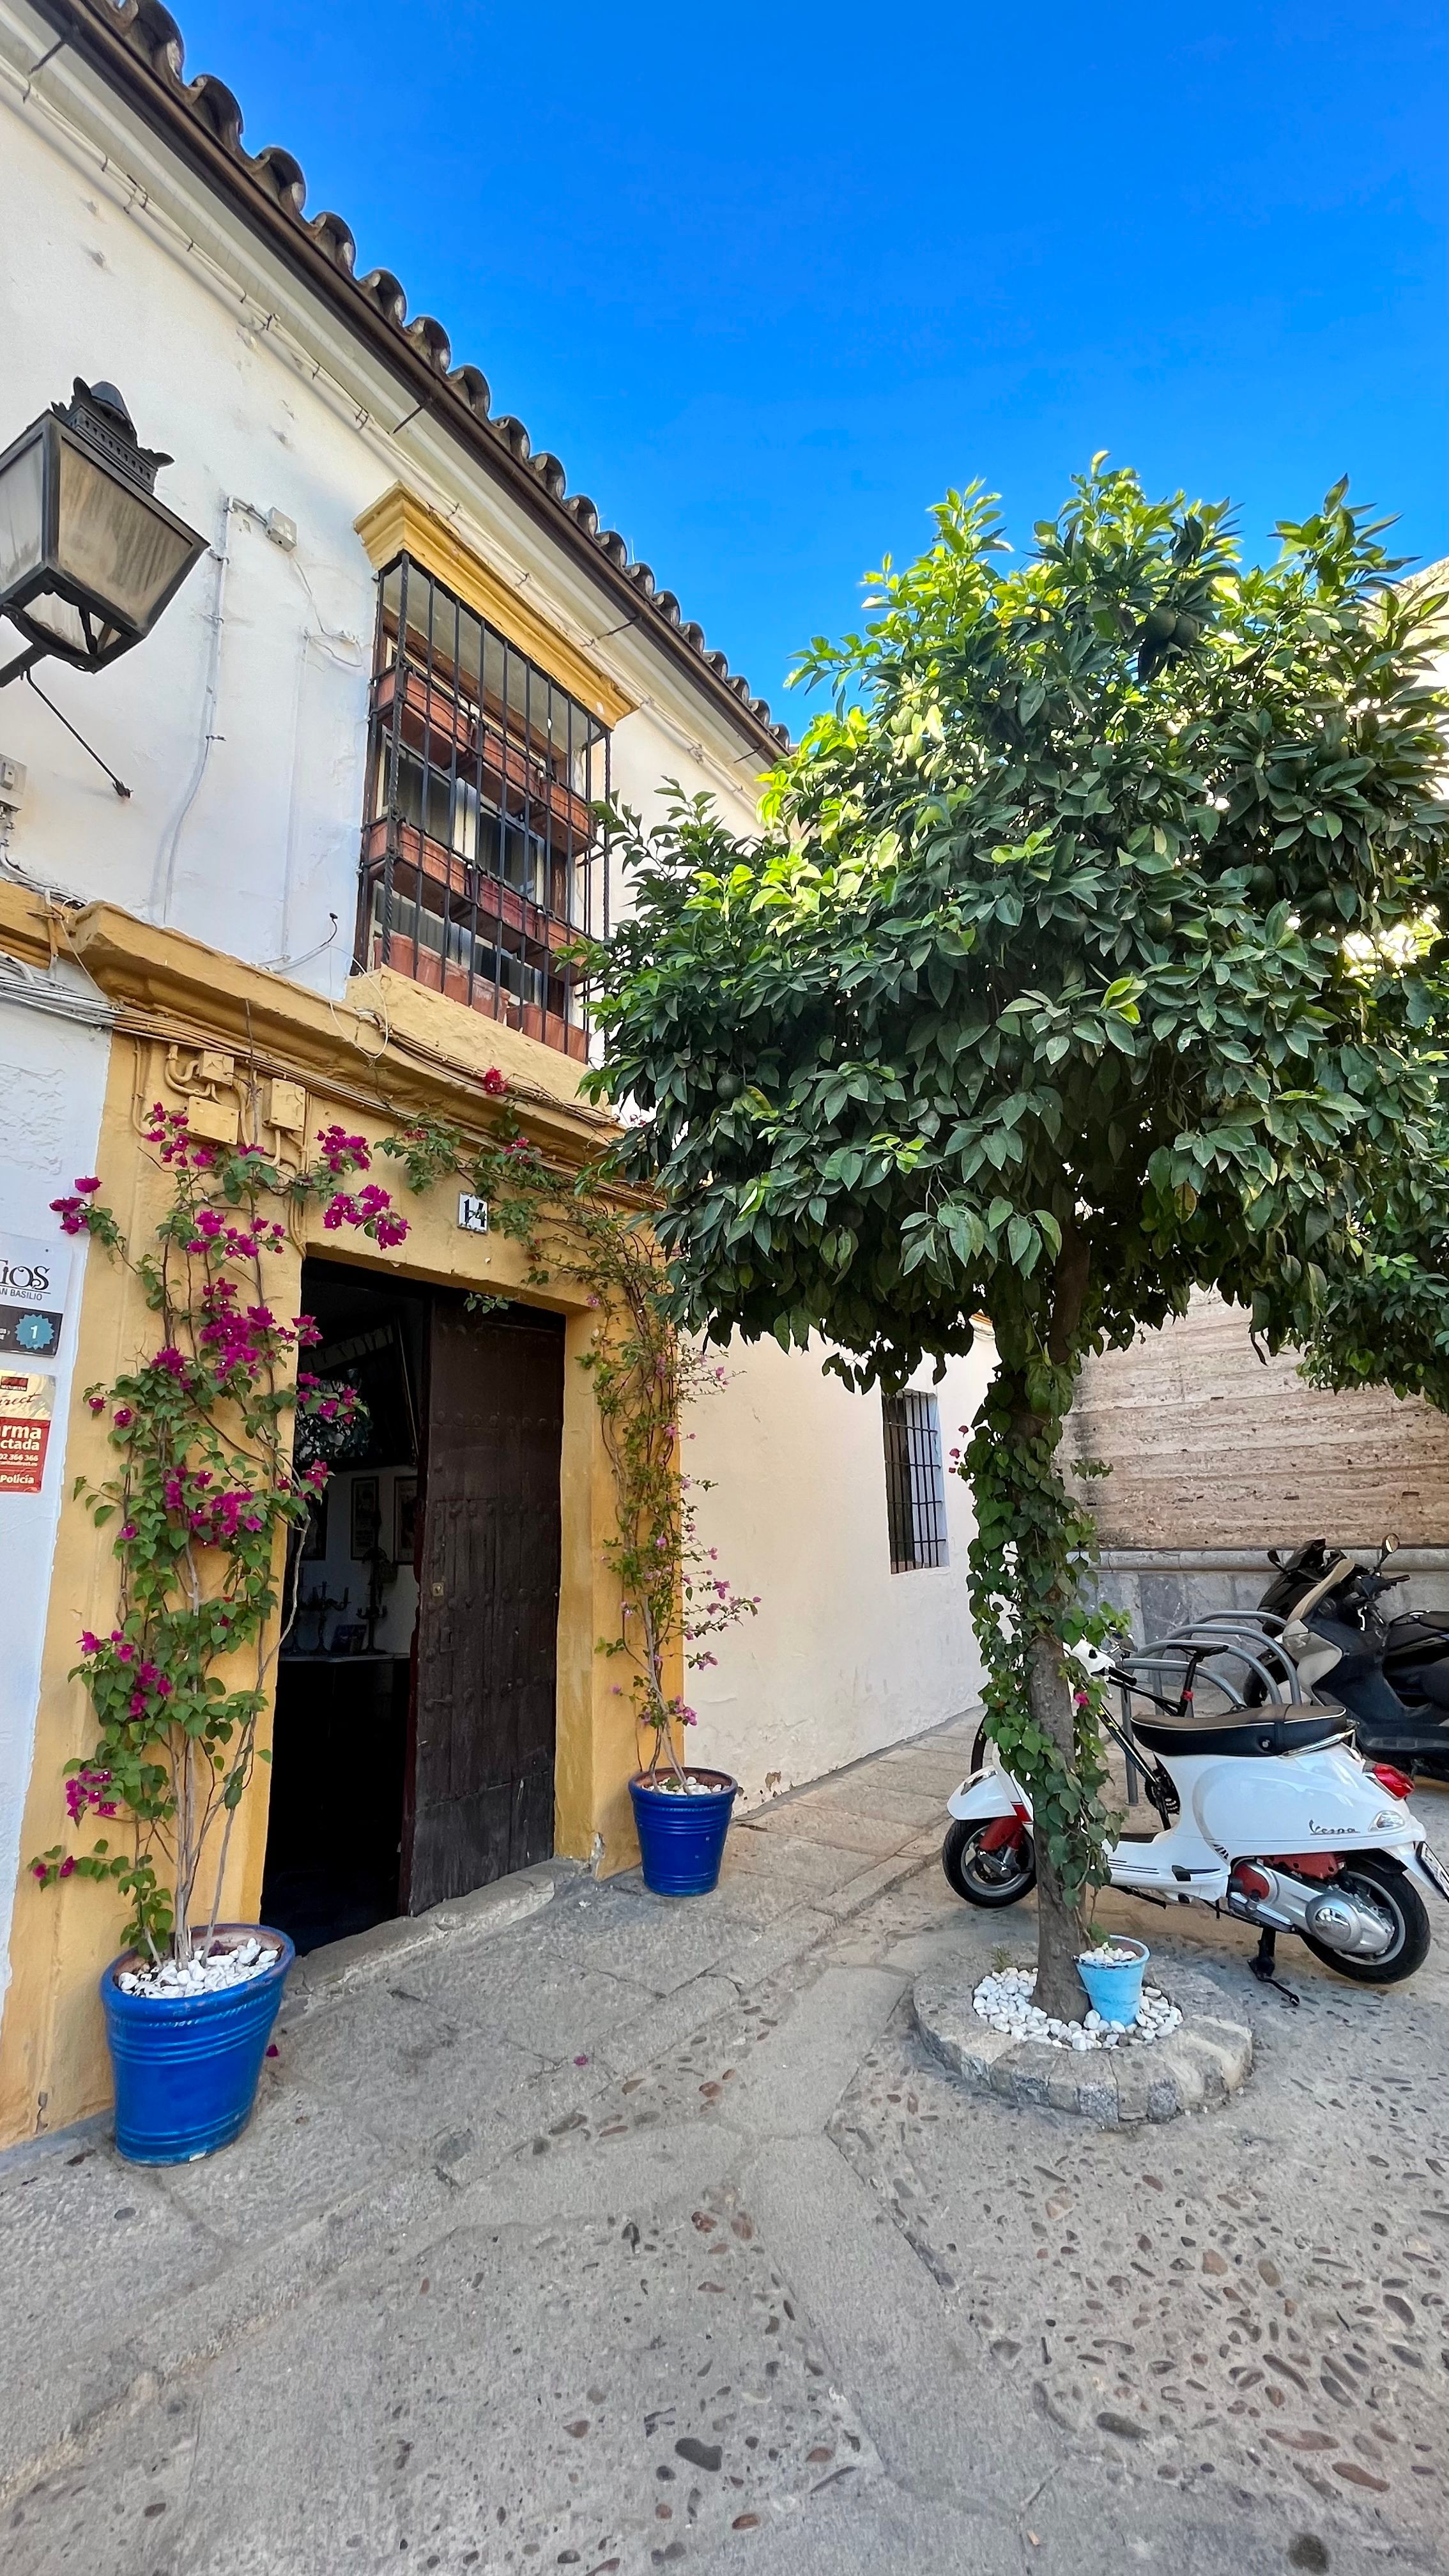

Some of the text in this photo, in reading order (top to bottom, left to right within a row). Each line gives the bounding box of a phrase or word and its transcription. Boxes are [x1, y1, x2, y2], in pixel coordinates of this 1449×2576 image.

[464, 1199, 487, 1227] 14
[10, 1289, 42, 1301] BASILIO
[30, 1325, 38, 1339] 1
[0, 1425, 42, 1440] rma
[1308, 1819, 1361, 1836] Vespa
